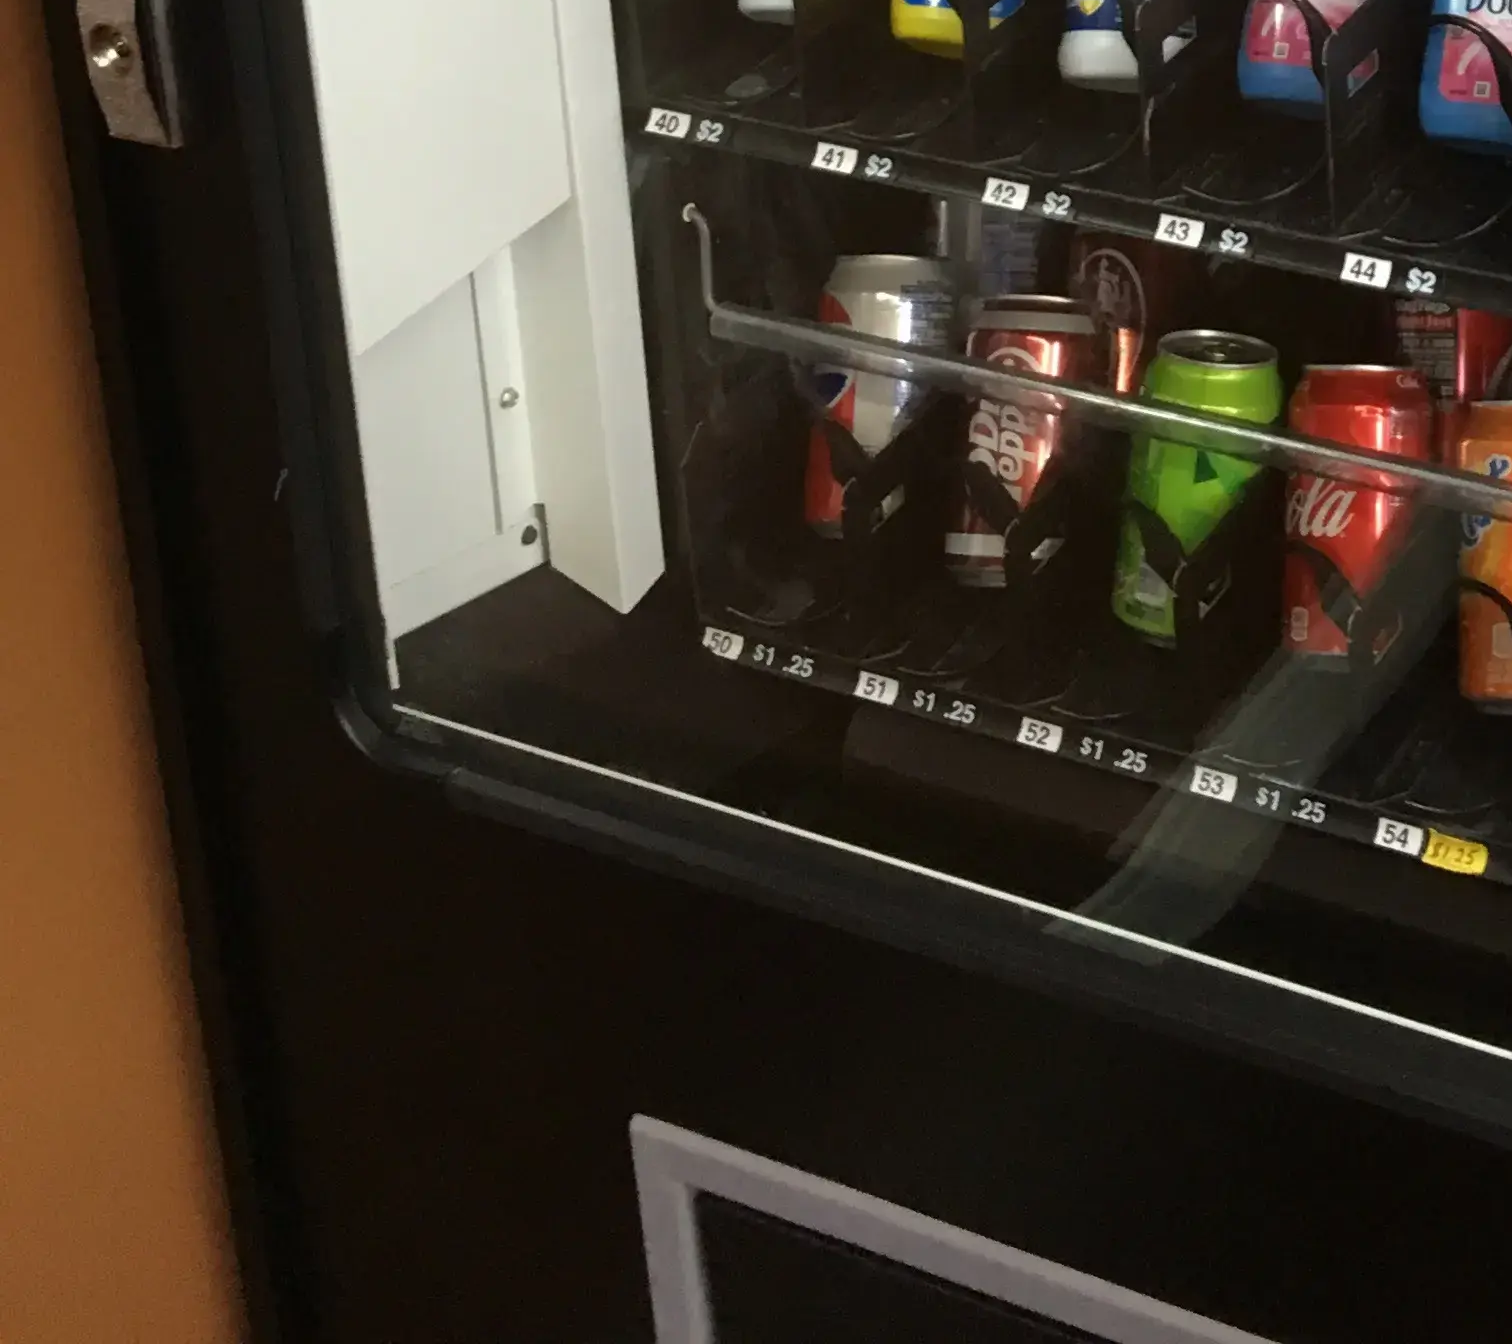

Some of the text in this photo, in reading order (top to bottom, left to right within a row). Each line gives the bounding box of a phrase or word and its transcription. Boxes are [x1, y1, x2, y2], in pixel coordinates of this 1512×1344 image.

[654, 113, 724, 143] 40 $2
[822, 148, 893, 179] 41 $2
[990, 183, 1072, 215] 42 $2
[1163, 219, 1249, 253] 43 $2
[1349, 259, 1437, 294] 44 $2
[709, 633, 814, 677] 50 $1 .25
[862, 678, 976, 723] 51 $1 .25
[1024, 723, 1148, 772] 52 $1 .25
[1198, 774, 1326, 824] 53 $1 .25
[1382, 825, 1410, 848] 54
